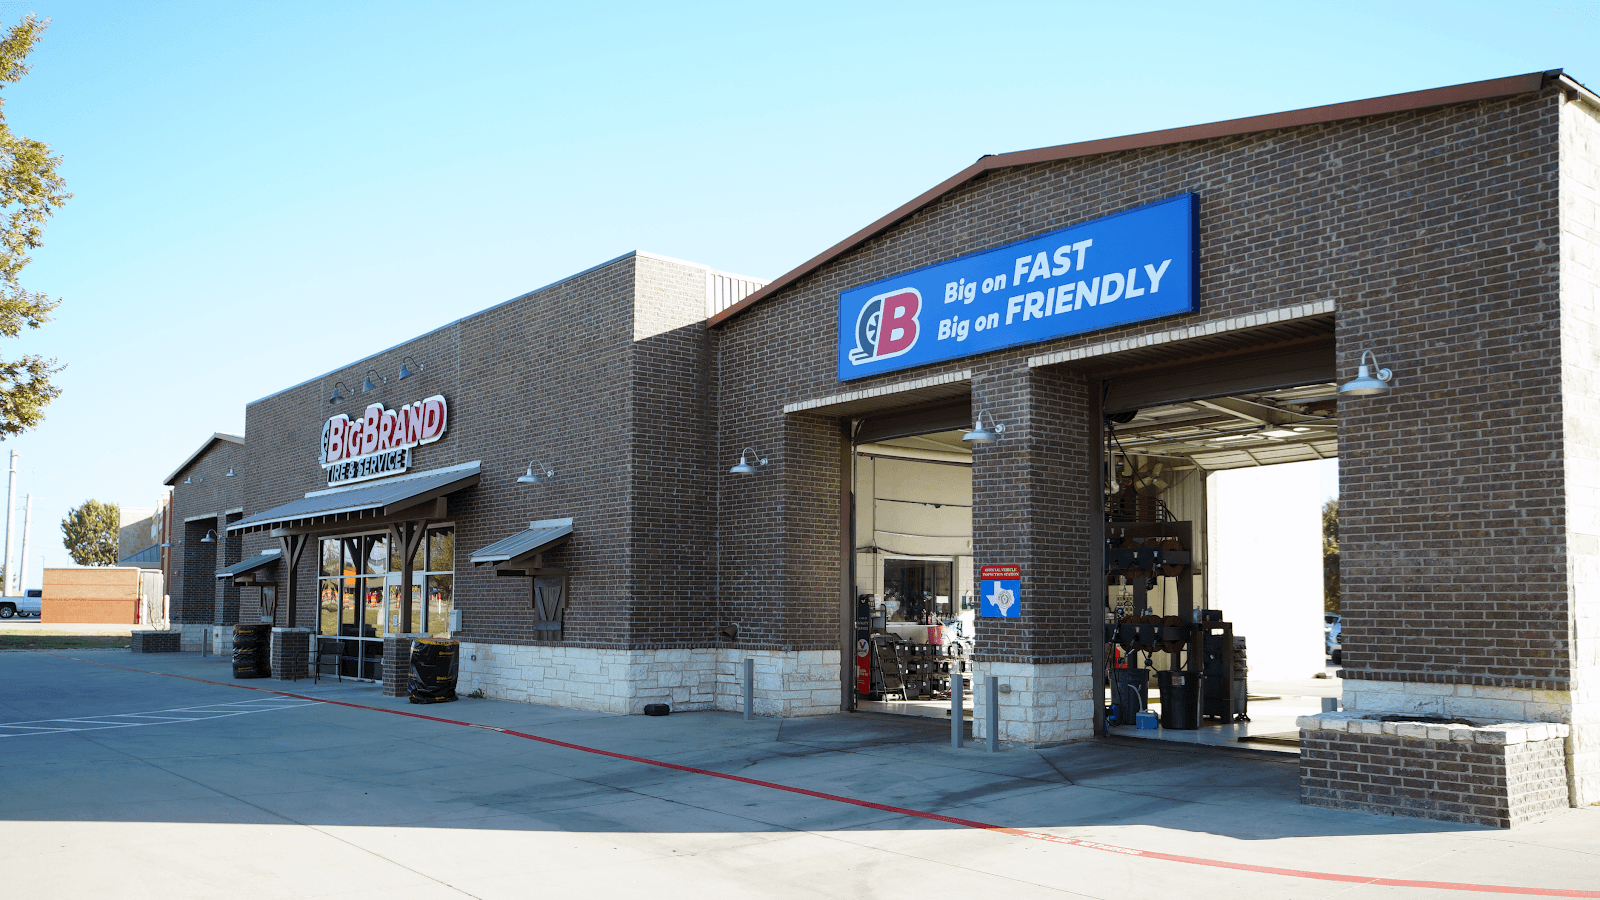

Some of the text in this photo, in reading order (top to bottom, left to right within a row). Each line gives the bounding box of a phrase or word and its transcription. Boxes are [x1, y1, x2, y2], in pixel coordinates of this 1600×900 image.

[937, 259, 1172, 341] Big on FRIENDLY
[944, 239, 1093, 304] Big on FAST
[326, 449, 407, 483] TIRE & SERVICE
